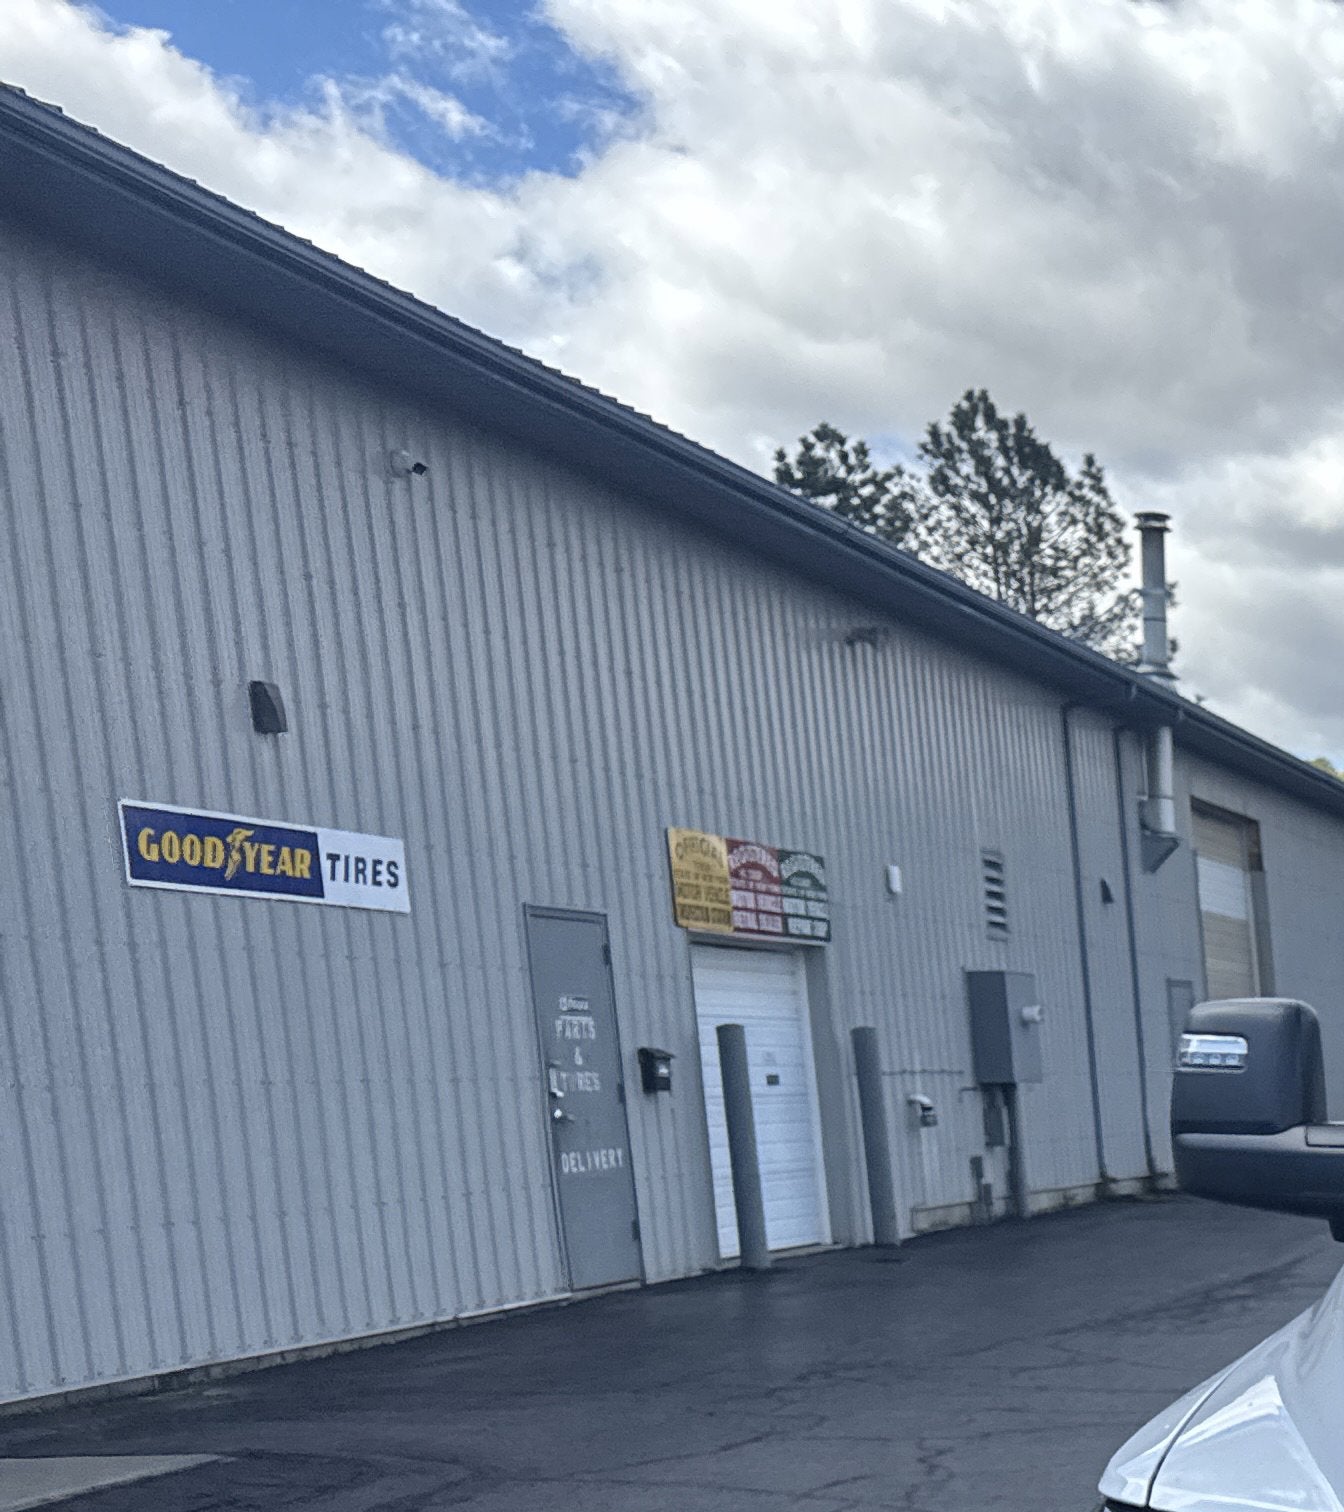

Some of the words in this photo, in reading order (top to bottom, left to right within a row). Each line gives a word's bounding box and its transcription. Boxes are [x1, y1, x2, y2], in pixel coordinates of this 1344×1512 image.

[137, 827, 312, 881] GOODYEAR
[326, 852, 399, 889] TIRES
[555, 1018, 596, 1040] PARTS
[561, 1148, 623, 1173] DELIVERY
